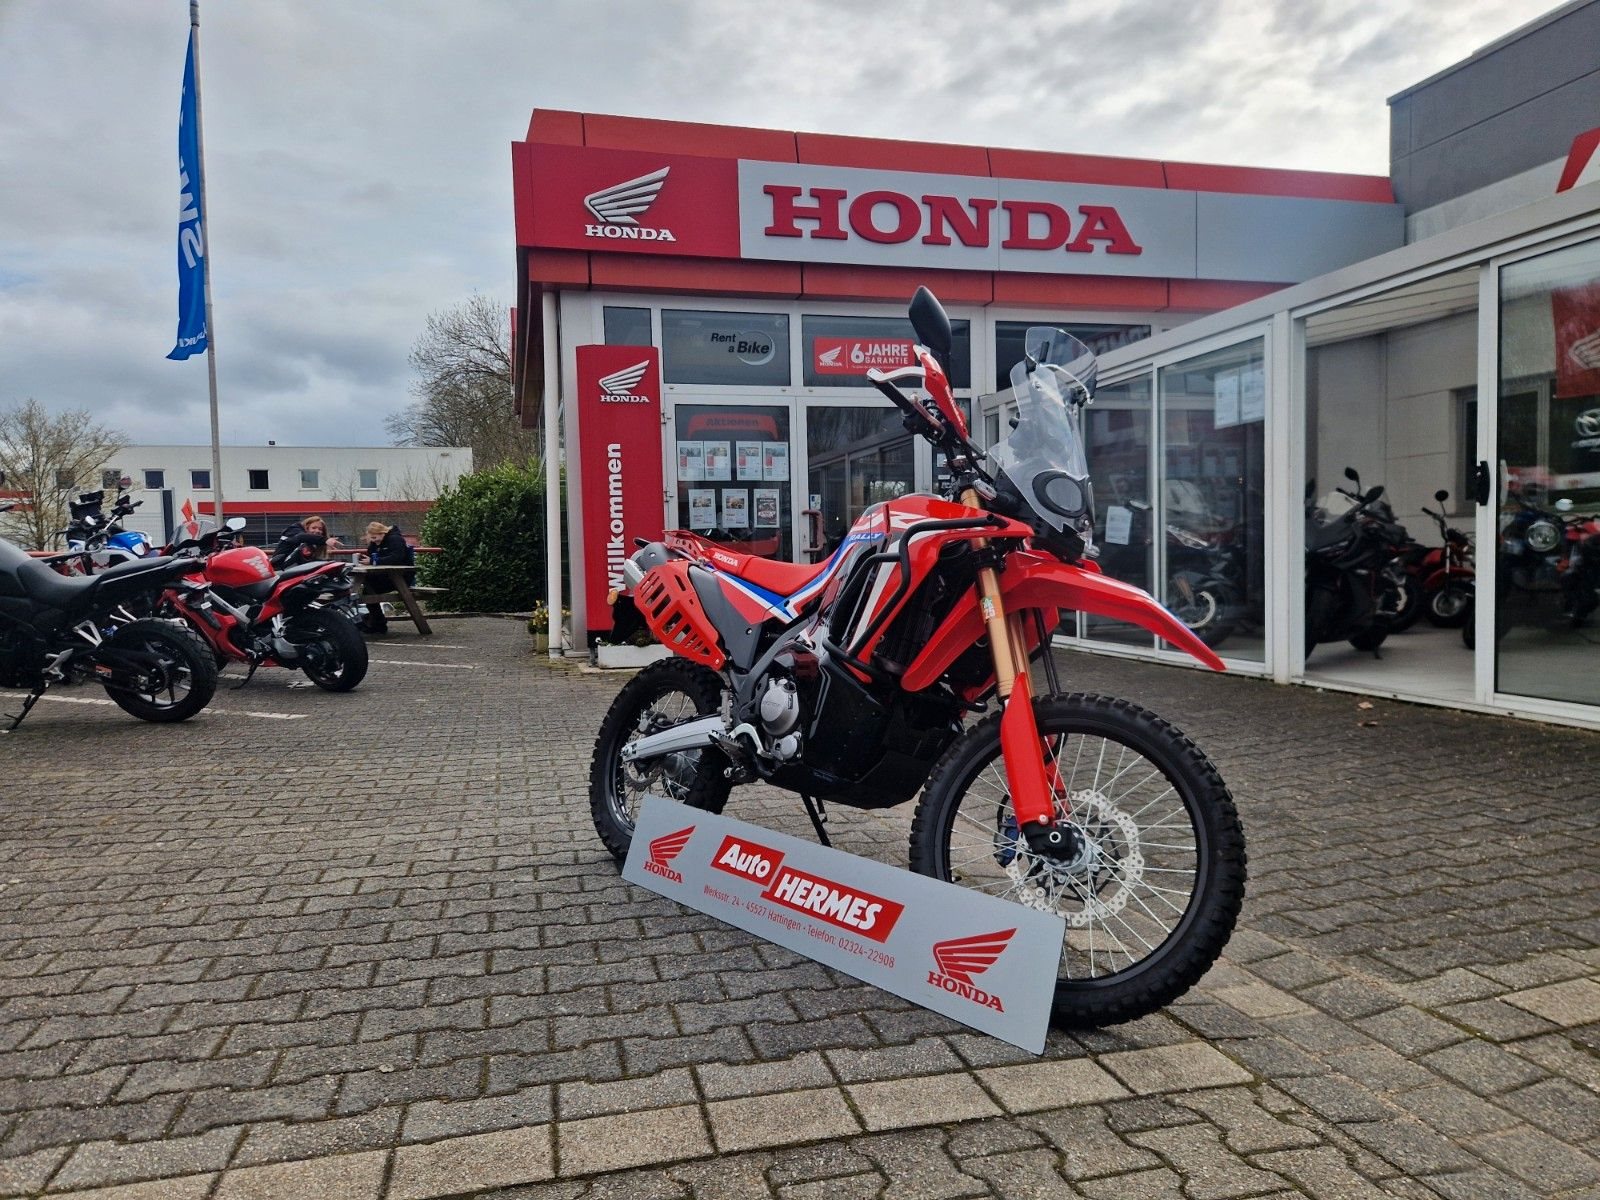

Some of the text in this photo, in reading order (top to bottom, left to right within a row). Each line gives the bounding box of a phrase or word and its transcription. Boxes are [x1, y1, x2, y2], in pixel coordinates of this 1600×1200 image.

[763, 184, 1143, 255] HONDA
[585, 224, 677, 242] HONDA
[711, 332, 737, 343] Rent
[728, 341, 770, 354] a Bike
[851, 343, 908, 364] 6 JAHRE
[865, 356, 909, 365] GARANTIE
[600, 394, 650, 403] HONDA
[607, 443, 626, 592] Willkommen
[849, 532, 882, 541] RALLY
[712, 551, 739, 567] HONDA
[719, 843, 771, 878] Auto
[643, 861, 683, 884] HONDA
[774, 873, 883, 930] HERMES
[746, 902, 767, 918] 45527
[767, 910, 801, 931] Hattingen
[807, 924, 837, 945] Telefon:
[838, 938, 896, 969] 02324-22908
[926, 970, 1005, 1013] HONDA
